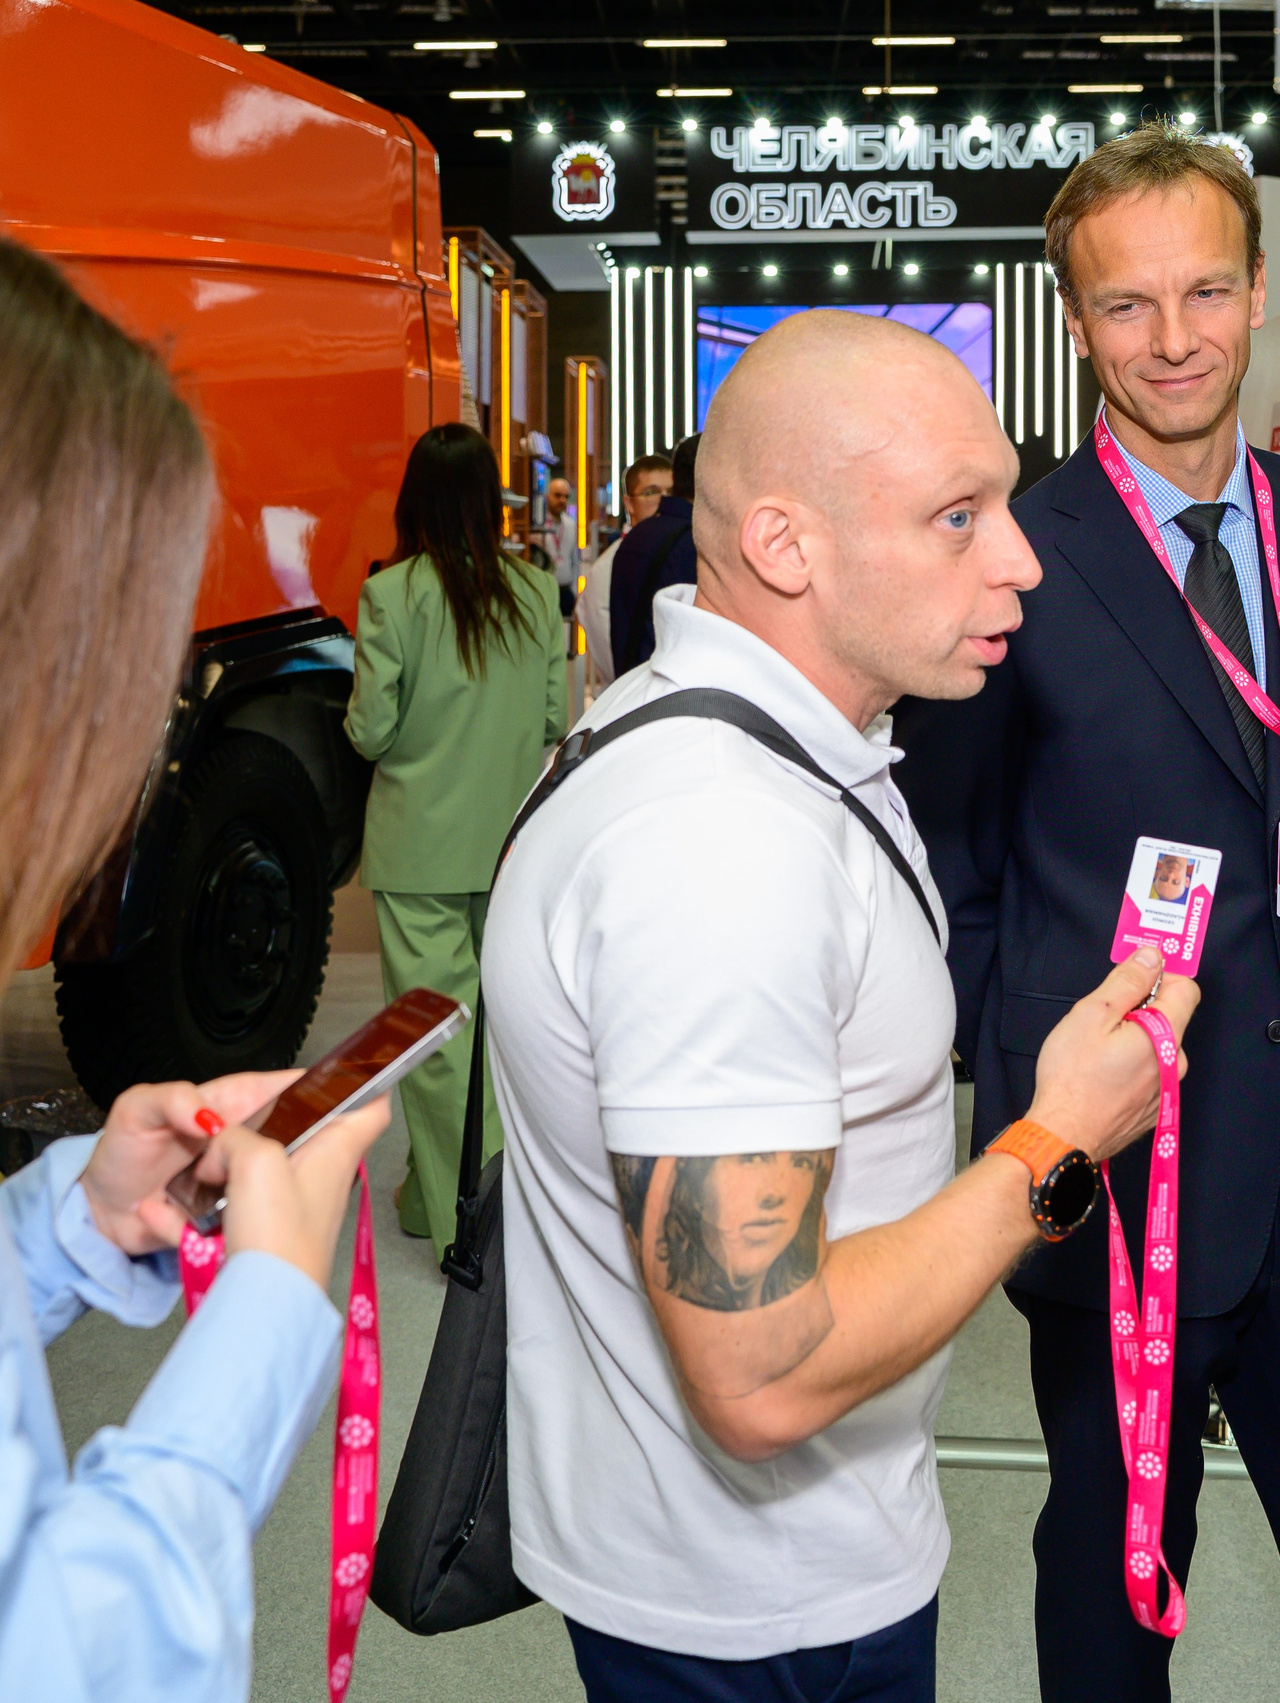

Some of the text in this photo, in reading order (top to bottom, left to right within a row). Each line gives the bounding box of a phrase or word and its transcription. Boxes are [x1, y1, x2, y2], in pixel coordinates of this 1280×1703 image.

[710, 122, 1095, 173] ЧЕЛЯБИНСКАЯ
[710, 180, 957, 230] ОБЛАСТЬ
[1181, 896, 1204, 961] EXHIBITOR
